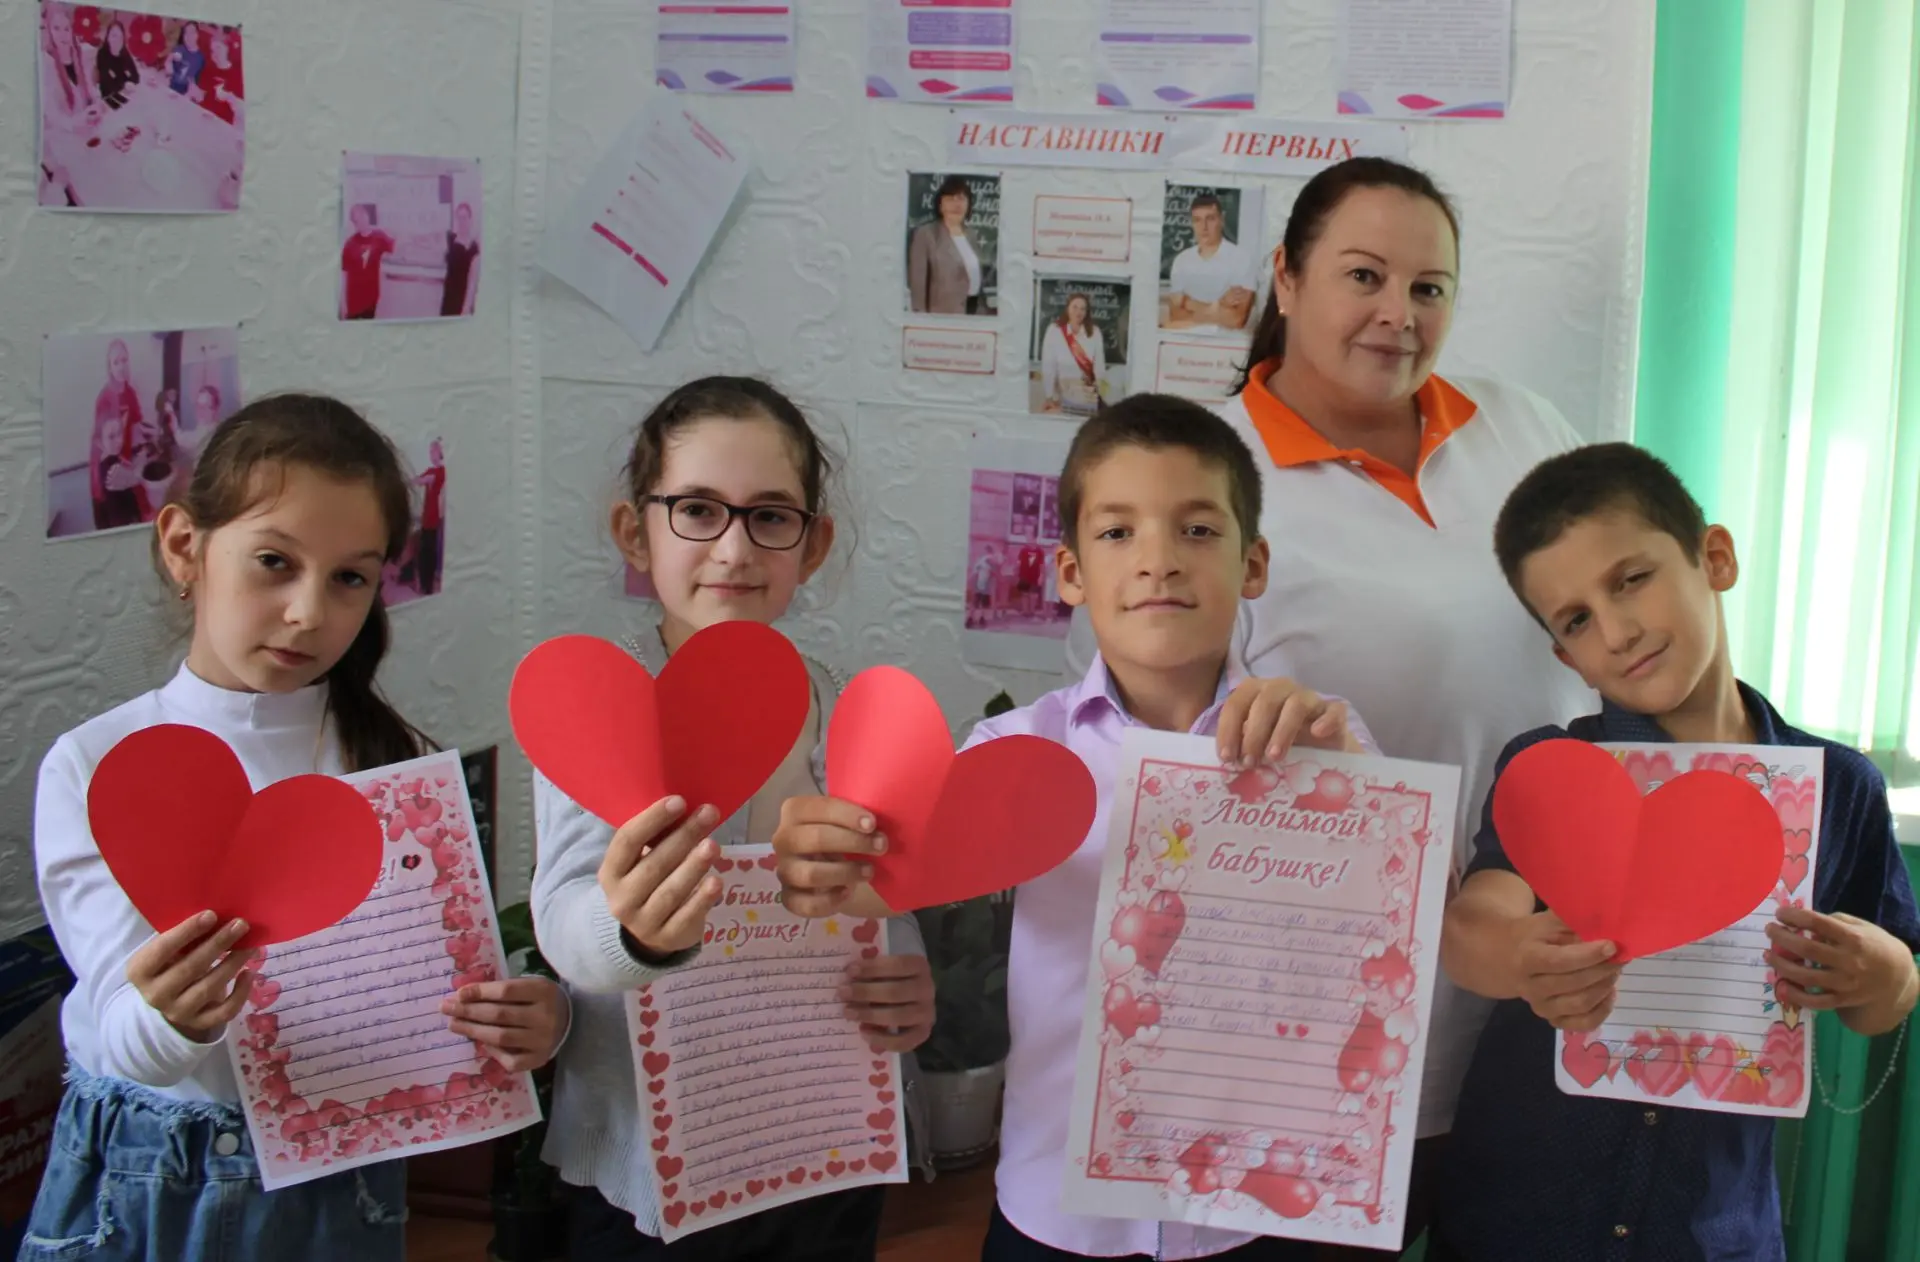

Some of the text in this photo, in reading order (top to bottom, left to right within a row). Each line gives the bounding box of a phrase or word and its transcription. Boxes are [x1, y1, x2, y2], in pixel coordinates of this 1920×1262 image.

[957, 122, 1360, 160] НАСТАВНИКИ ПЕРВЫХ
[1201, 798, 1361, 837] Любимой
[1207, 841, 1350, 889] бабушке!
[713, 883, 783, 907] бимо
[703, 918, 811, 948] дедушке!
